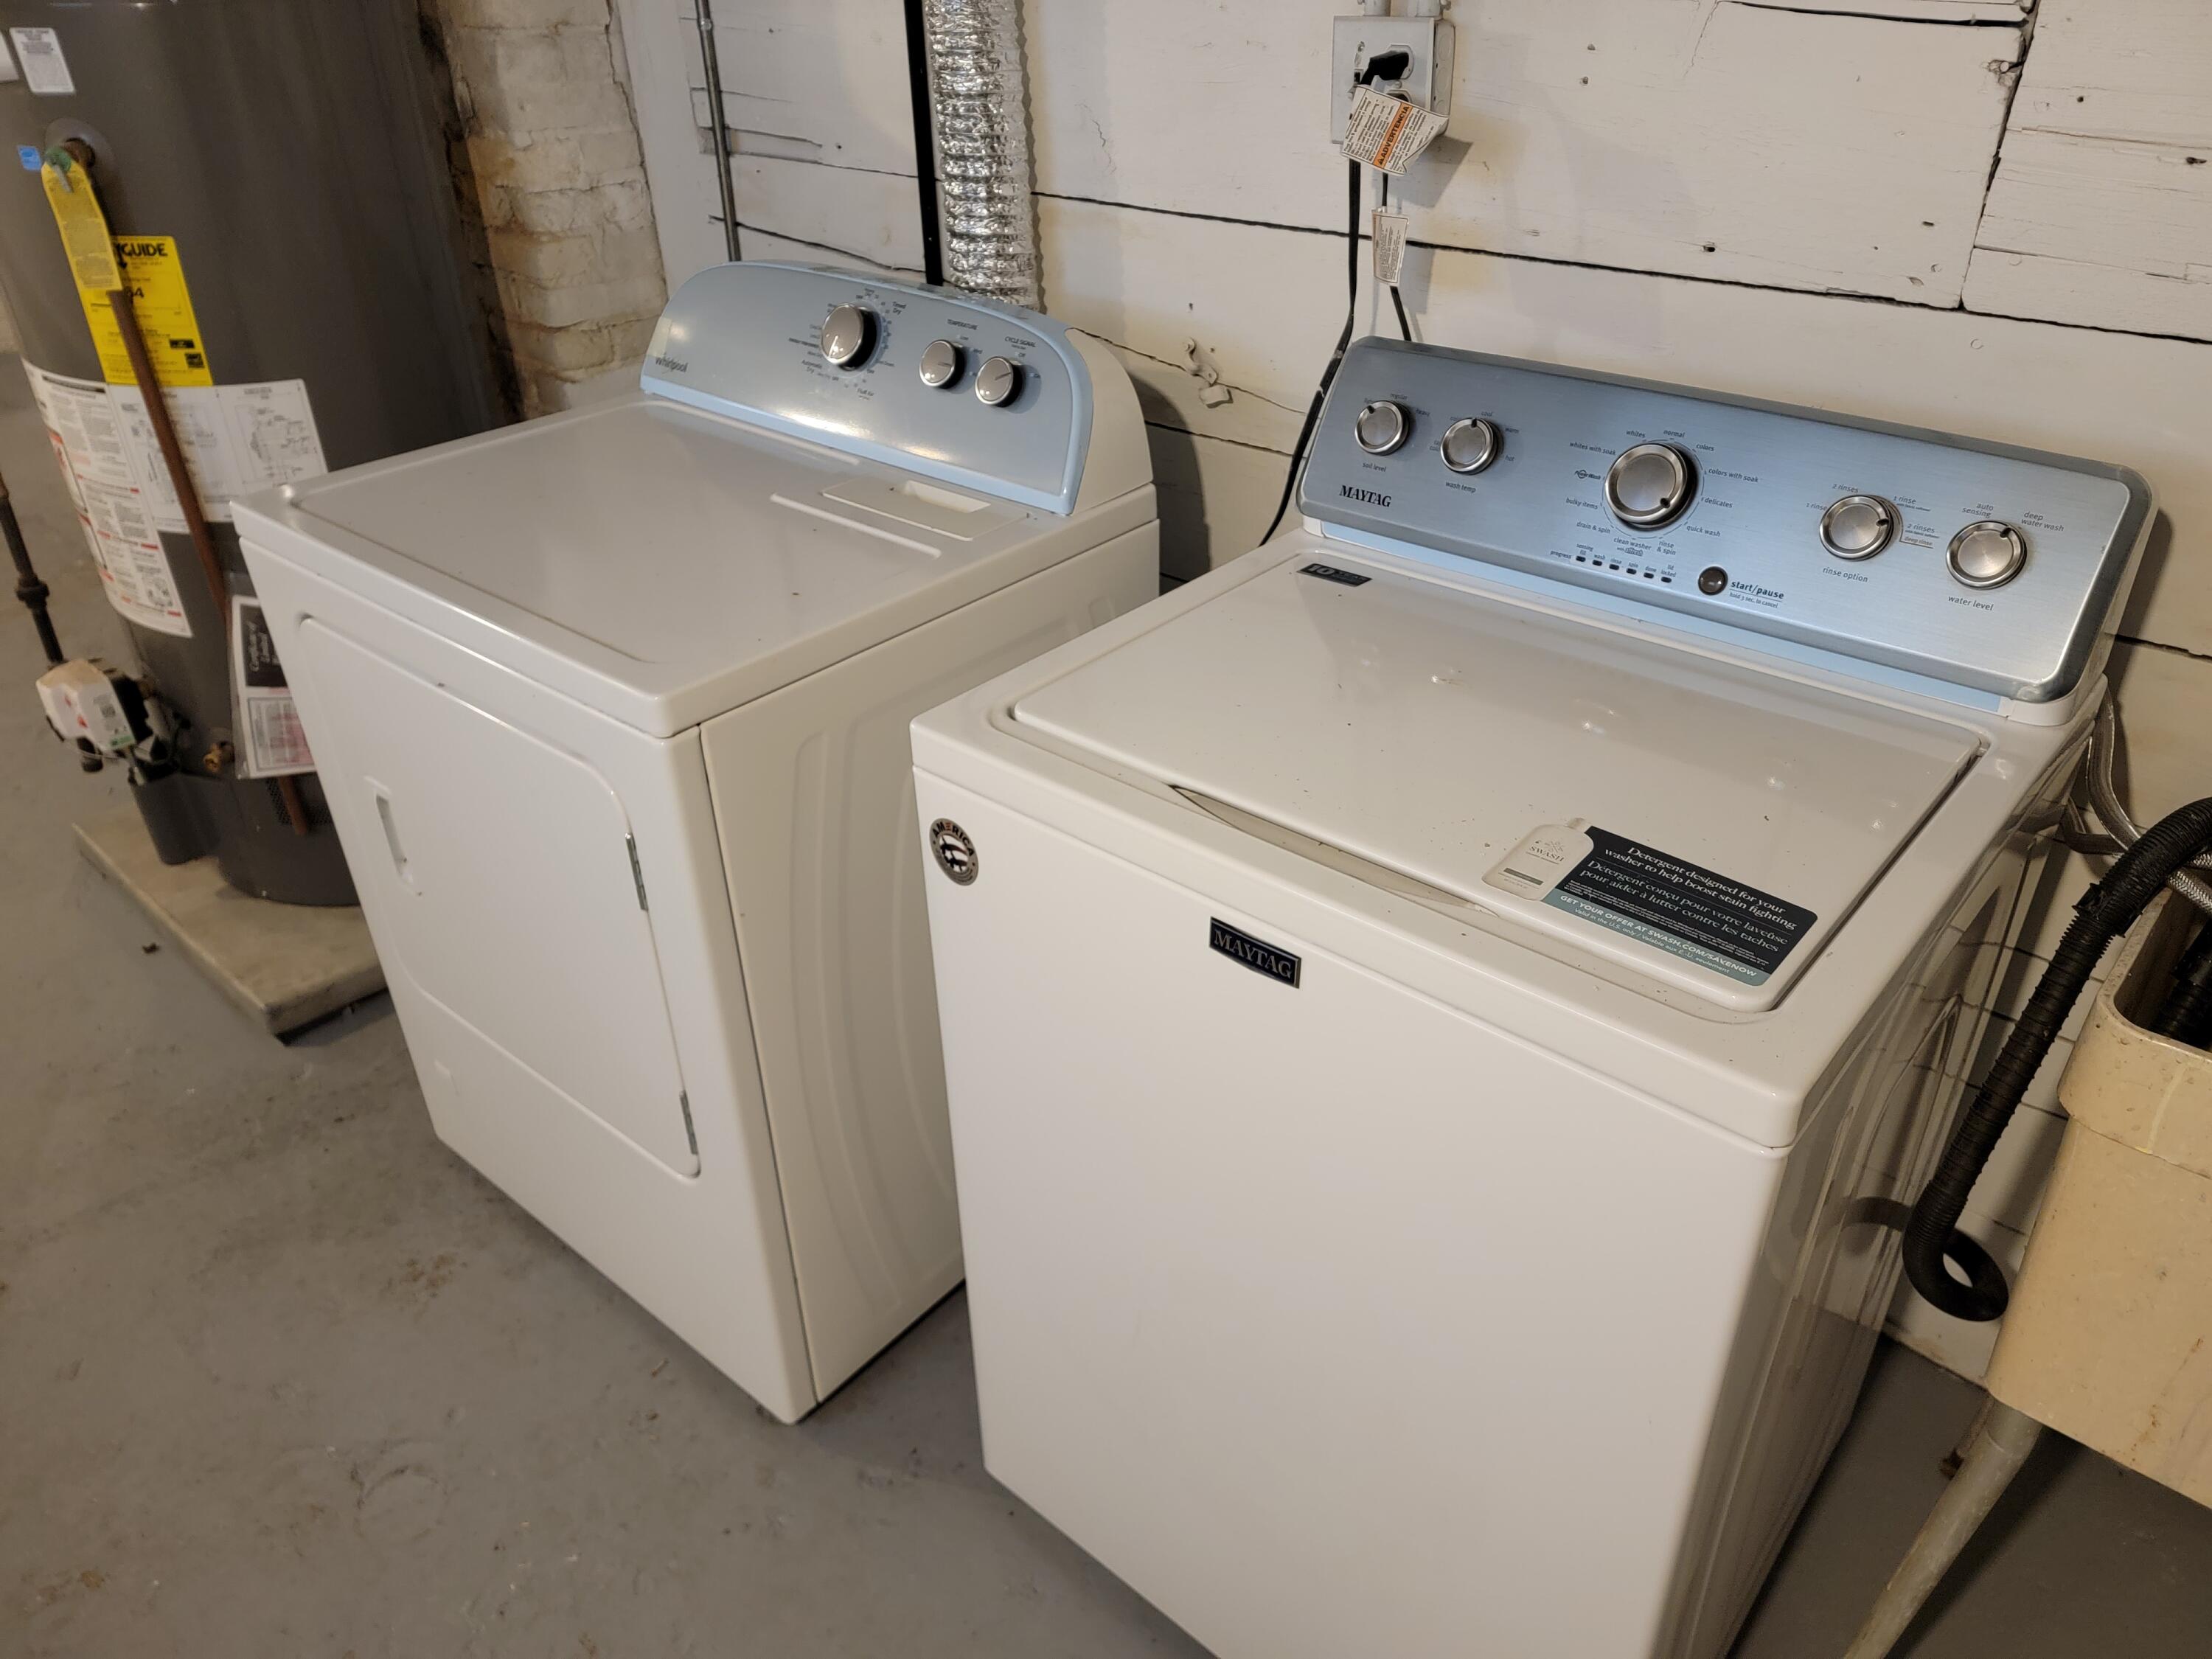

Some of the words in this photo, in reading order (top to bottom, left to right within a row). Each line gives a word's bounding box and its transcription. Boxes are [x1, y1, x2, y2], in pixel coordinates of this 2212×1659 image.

[1380, 105, 1409, 157] ADVERTENCIA
[947, 319, 978, 330] TEMPERATURE
[655, 356, 689, 372] Whirlpool
[1626, 430, 1646, 438] whites
[1663, 429, 1685, 438] normal
[1696, 443, 1715, 451] colors
[1362, 462, 1374, 470] soil
[1374, 464, 1387, 473] level
[1708, 467, 1728, 476] colors
[1445, 481, 1461, 490] wash
[1461, 484, 1476, 493] temp
[1838, 484, 1859, 493] rinses
[1339, 484, 1392, 508] MAYTAG
[1898, 495, 1916, 504] rinse
[1565, 497, 1582, 507] bulky
[1582, 501, 1598, 509] items
[1705, 497, 1733, 508] delicates
[1810, 503, 1827, 511] rinse
[1976, 503, 1994, 511] auto
[1961, 507, 1992, 519] sensing
[2023, 511, 2044, 521] deep
[1576, 521, 1592, 529] drain
[1598, 526, 1611, 535] spin
[1686, 525, 1703, 534] quick
[1913, 524, 1935, 533] rinses
[2021, 518, 2042, 528] water
[2043, 523, 2065, 532] wash
[1576, 543, 1593, 552] sensing
[1613, 538, 1629, 546] clean
[1630, 540, 1652, 551] washer
[1659, 540, 1674, 549] rinse
[1550, 550, 1572, 560] progress
[1663, 547, 1677, 556] spin
[1309, 564, 1335, 575] 10
[1660, 569, 1677, 577] locked
[1822, 566, 1842, 577] rinse
[1843, 572, 1868, 582] option
[1731, 581, 1784, 599] start/pause
[1761, 599, 1778, 608] cancel
[1948, 595, 1972, 606] water
[1972, 600, 1994, 611] level
[932, 821, 975, 856] AMERICA
[1529, 846, 1565, 862] SWASH
[1627, 847, 1686, 874] Detergent
[1686, 866, 1738, 895] designed
[1739, 891, 1757, 902] for
[1755, 900, 1787, 914] your
[1587, 860, 1646, 887] Détergent
[1645, 881, 1680, 901] conçu
[1680, 898, 1712, 914] pour
[1711, 910, 1742, 926] votre
[1605, 849, 1645, 868] washer
[1644, 863, 1658, 873] to
[1658, 869, 1683, 884] help
[1685, 879, 1719, 897] boost
[1718, 894, 1747, 910] stain
[1748, 905, 1798, 931] fighting
[1579, 870, 1610, 883] pour
[1609, 879, 1641, 895] aider
[1639, 890, 1648, 899] à
[1648, 894, 1683, 912] lutter
[1681, 909, 1721, 928] contre
[1721, 924, 1739, 936] les
[1739, 933, 1779, 952] taches
[1560, 895, 1580, 905] GET
[1579, 902, 1604, 916] YOUR
[1604, 913, 1635, 928] OFFER
[1647, 930, 1757, 976] SWASH.COM/SAVENOW
[1575, 908, 1590, 917] Valid
[1597, 916, 1607, 924] the
[1622, 927, 1635, 936] only
[1641, 934, 1664, 947] Valable
[1695, 957, 1731, 973] seulement
[1214, 928, 1293, 979] MAYTAG
